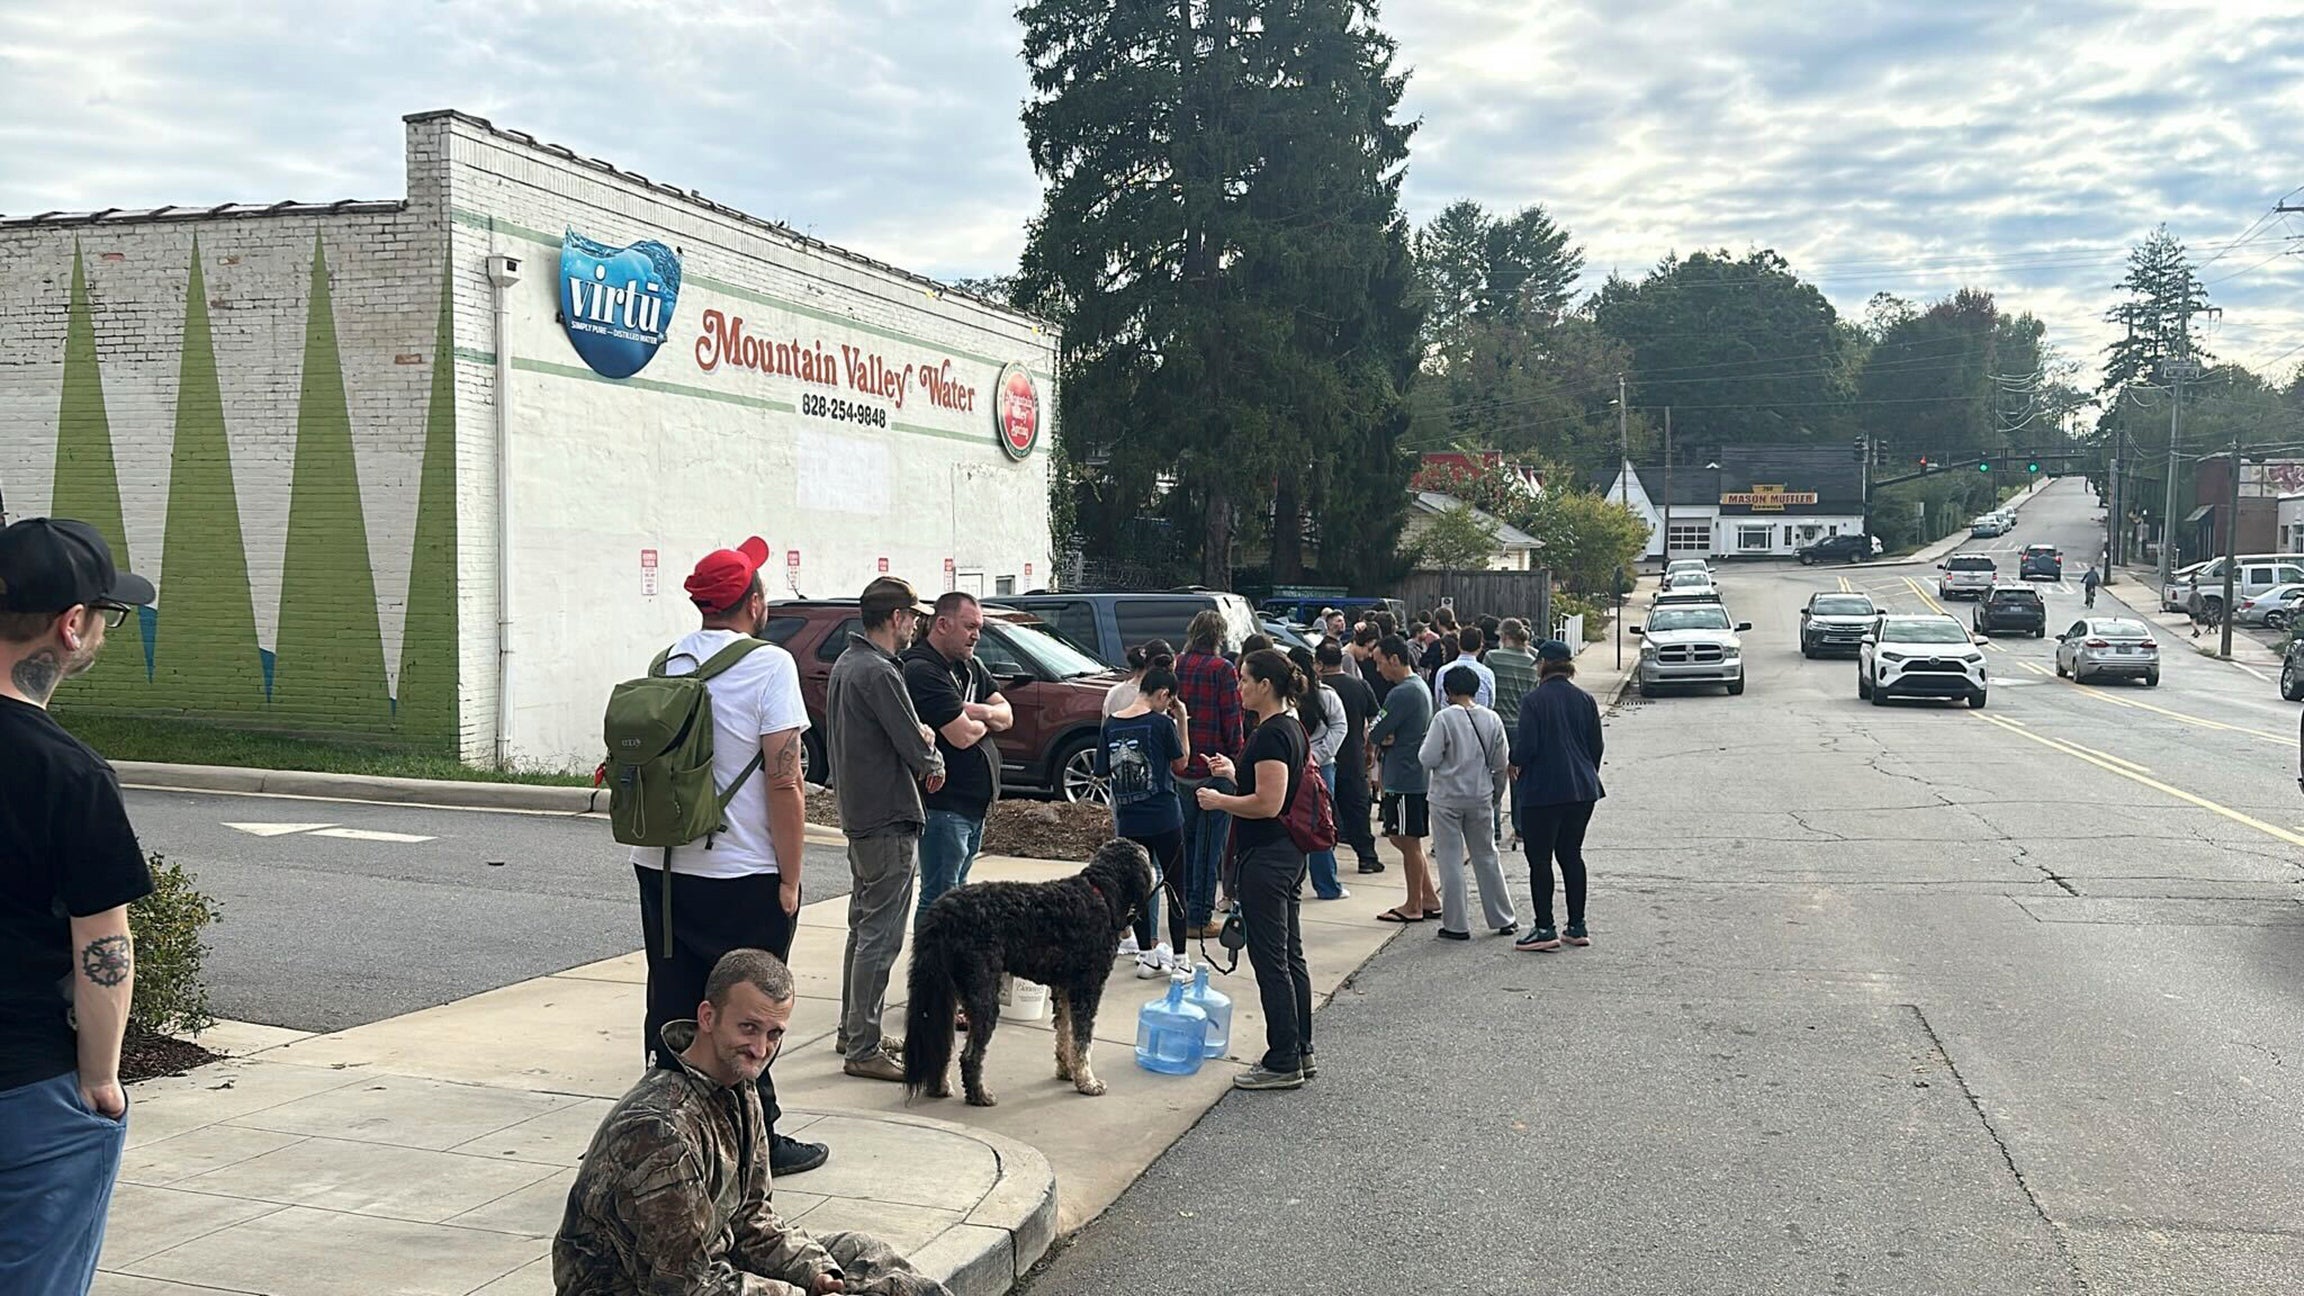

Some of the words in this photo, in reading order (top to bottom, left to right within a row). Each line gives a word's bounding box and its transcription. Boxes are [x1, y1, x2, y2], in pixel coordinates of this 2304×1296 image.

[571, 320, 593, 332] SIMPLY
[592, 324, 608, 335] PURE
[613, 328, 640, 341] DISTILLED
[639, 334, 658, 345] WATER
[695, 308, 838, 387] Mountain
[841, 344, 913, 409] Valley
[919, 358, 975, 412] Water
[802, 392, 886, 429] 828-254-9848
[1728, 494, 1766, 504] MASON
[1770, 494, 1813, 504] MUFFLER
